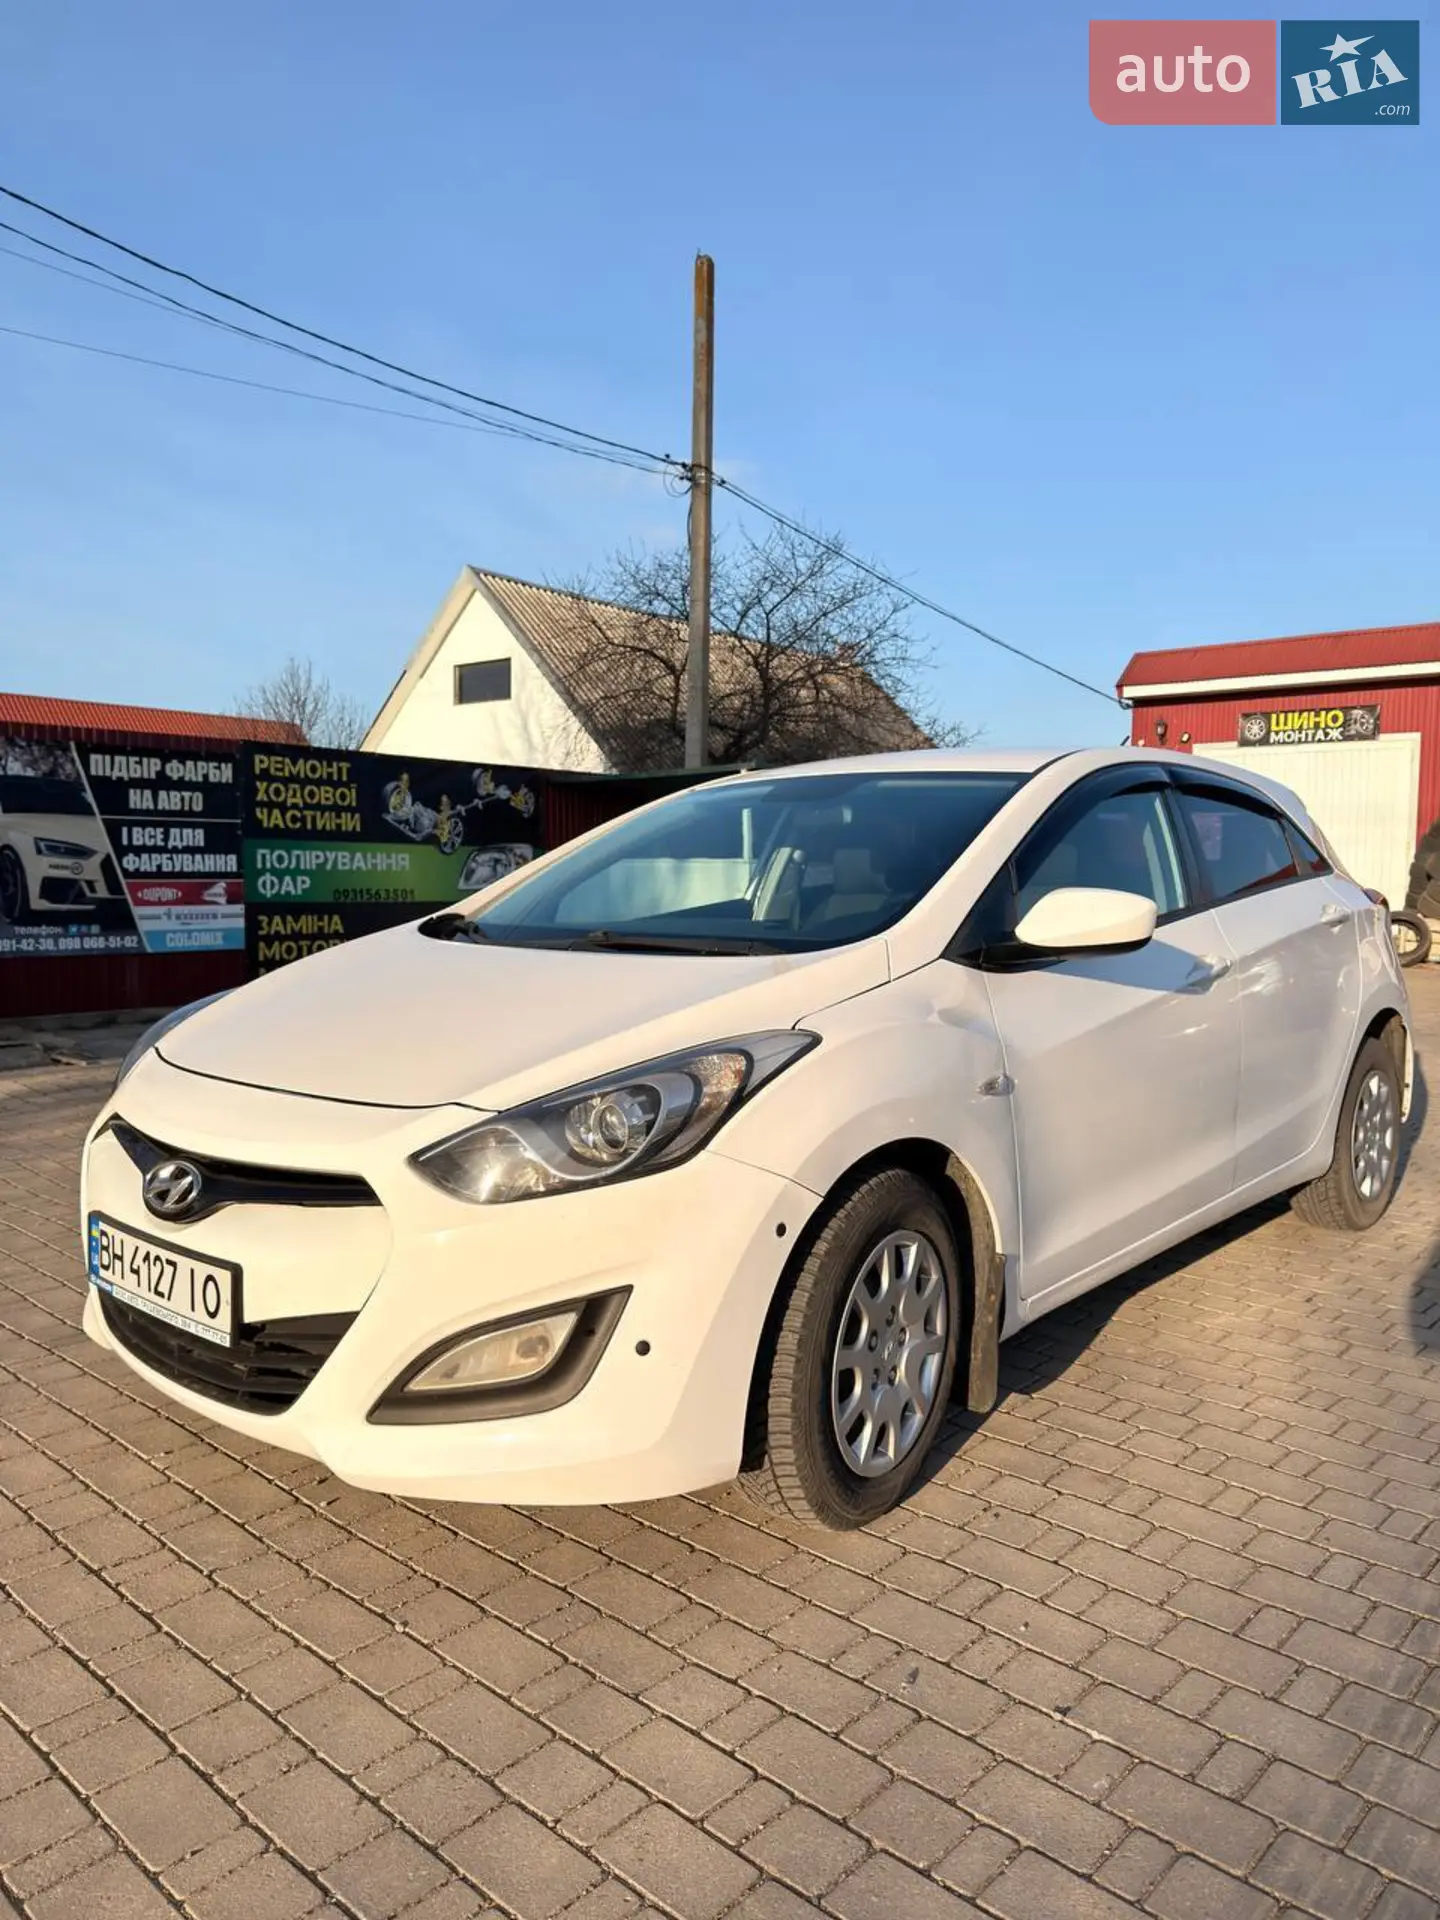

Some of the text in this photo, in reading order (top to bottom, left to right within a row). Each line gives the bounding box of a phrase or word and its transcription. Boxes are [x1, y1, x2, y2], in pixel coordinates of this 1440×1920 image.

[1271, 710, 1344, 731] ШИНО
[1270, 727, 1344, 744] МОНТАЖ
[89, 753, 233, 783] ПІДБІР ФАРБИ
[253, 754, 351, 781] РЕМОНТ
[128, 788, 204, 812] НА АВТО
[255, 780, 357, 808] ХОДОВОЇ
[255, 808, 361, 832] ЧАСТИНИ
[121, 826, 204, 849] І ВСЕ ДЛЯ
[122, 853, 238, 873] ФАРБУВАННЯ
[256, 848, 410, 872] ПОЛІРУВАННЯ
[257, 873, 311, 897] ФАР
[257, 915, 344, 936] ЗАМІНА
[100, 1229, 124, 1280] BH
[130, 1245, 178, 1302] 4127
[190, 1267, 221, 1320] IO
